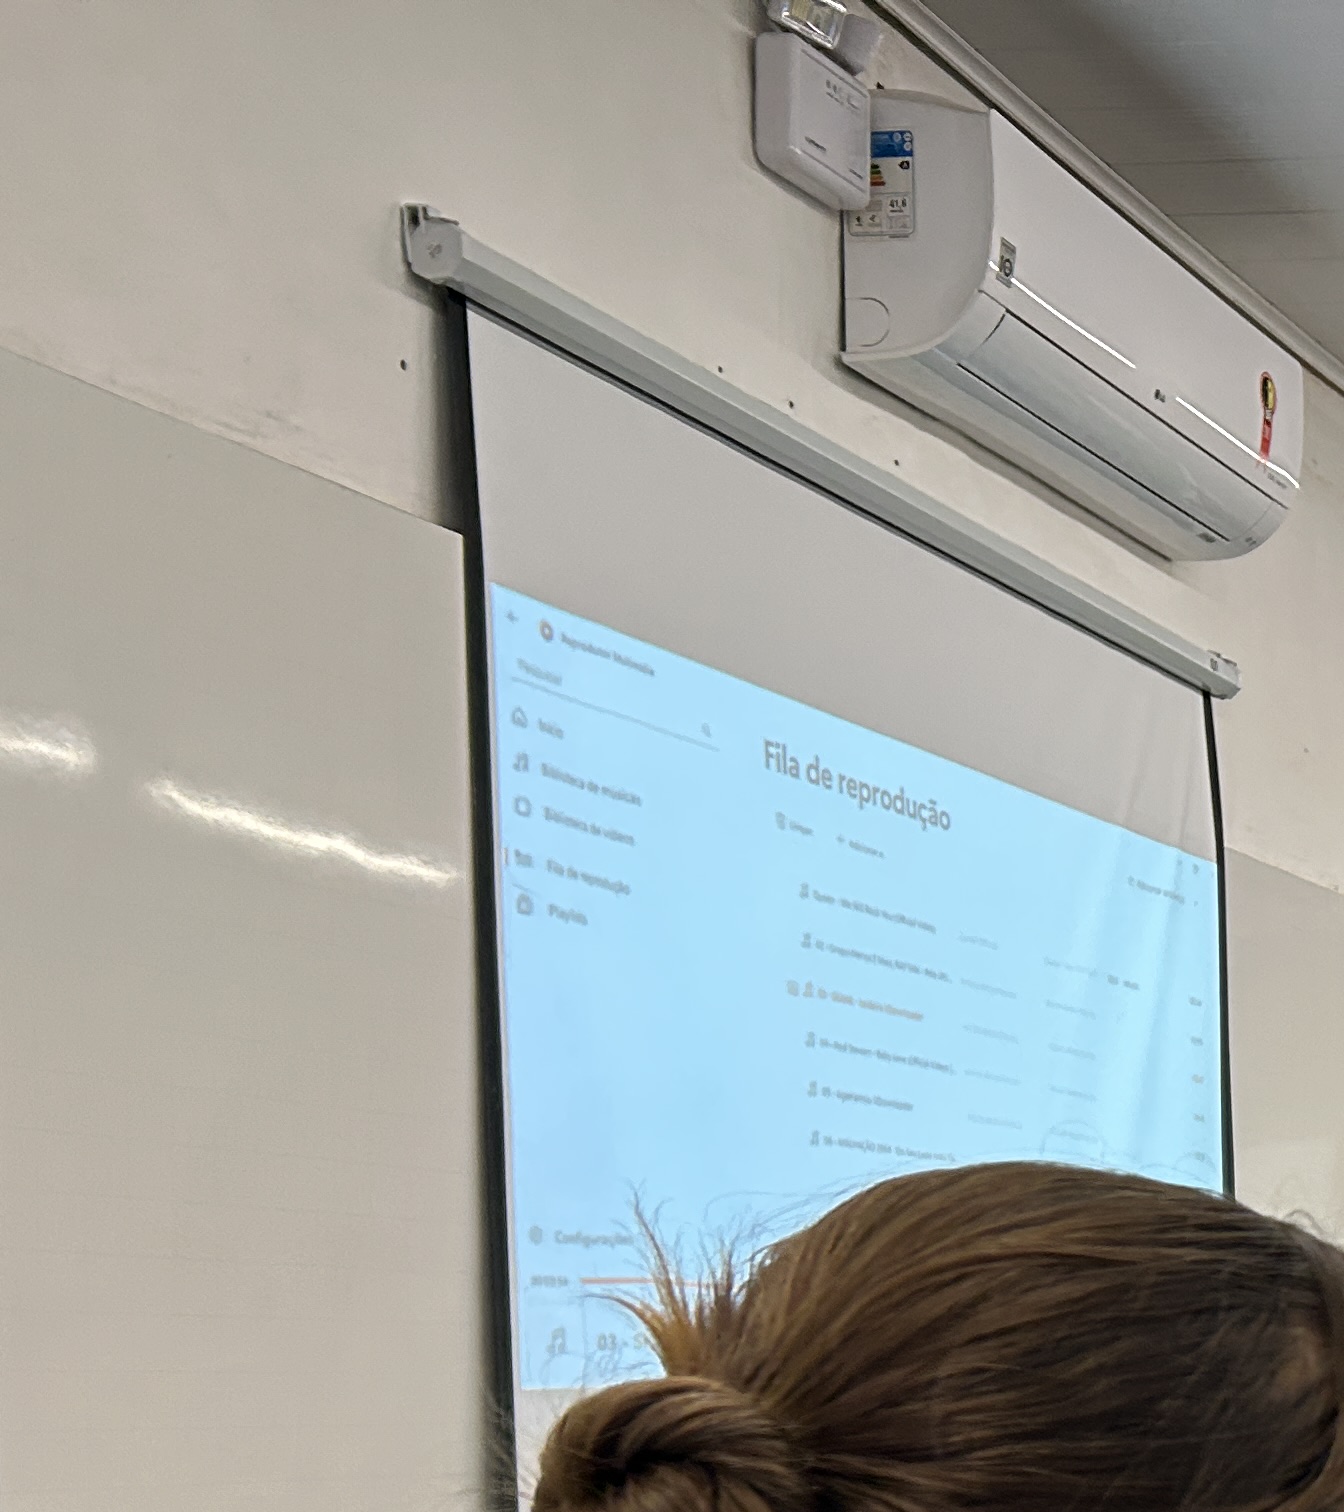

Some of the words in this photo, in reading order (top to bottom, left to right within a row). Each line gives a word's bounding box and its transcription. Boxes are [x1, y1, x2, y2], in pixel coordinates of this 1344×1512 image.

[763, 738, 801, 780] Fila
[805, 754, 833, 790] de
[838, 771, 952, 832] reprodução
